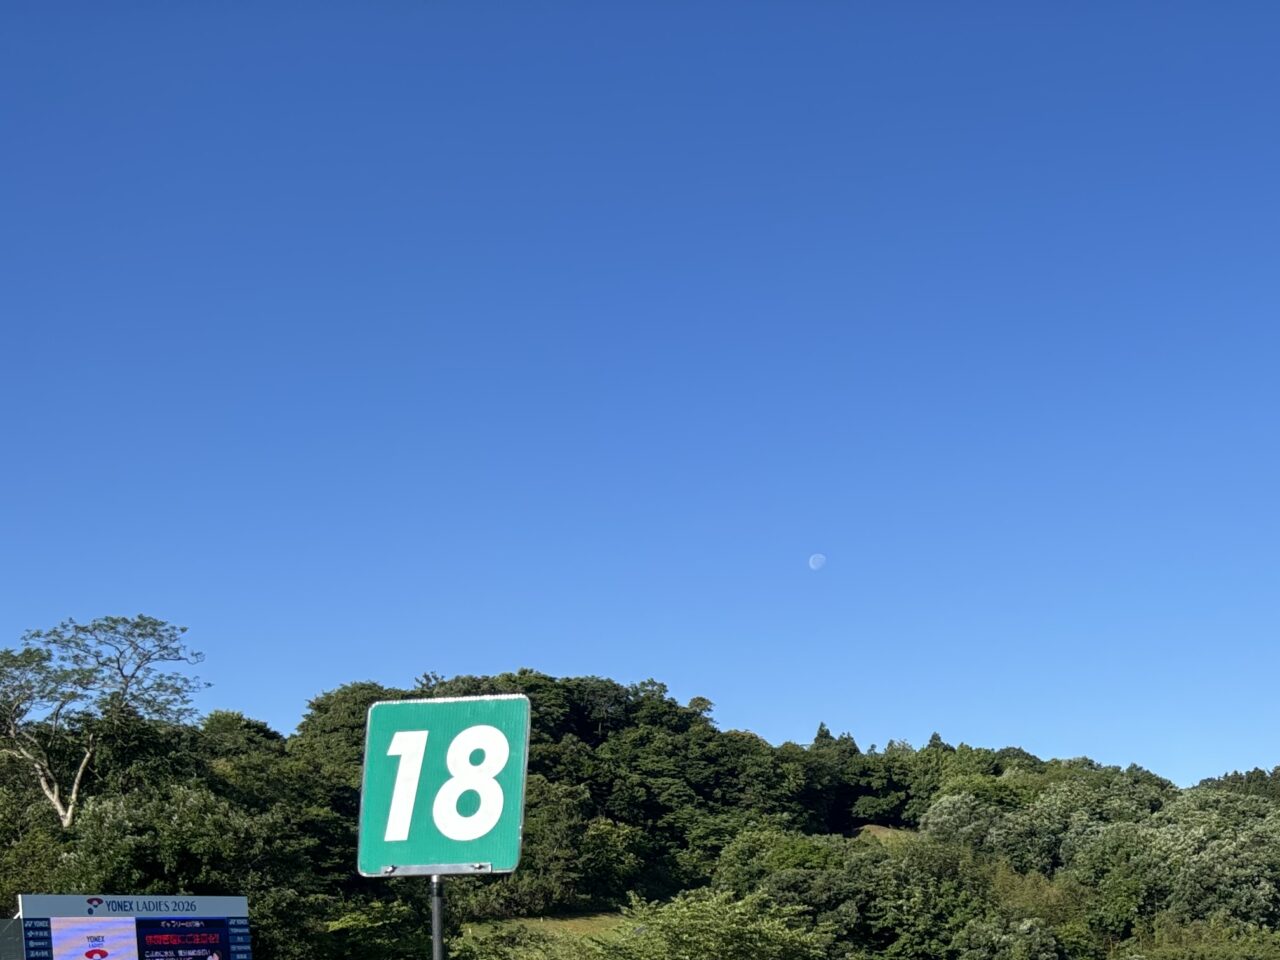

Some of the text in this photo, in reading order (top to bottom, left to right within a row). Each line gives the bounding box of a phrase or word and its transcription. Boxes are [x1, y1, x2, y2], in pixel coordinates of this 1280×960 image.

[384, 725, 510, 842] 18
[106, 900, 197, 912] YONEX LADIES 2026
